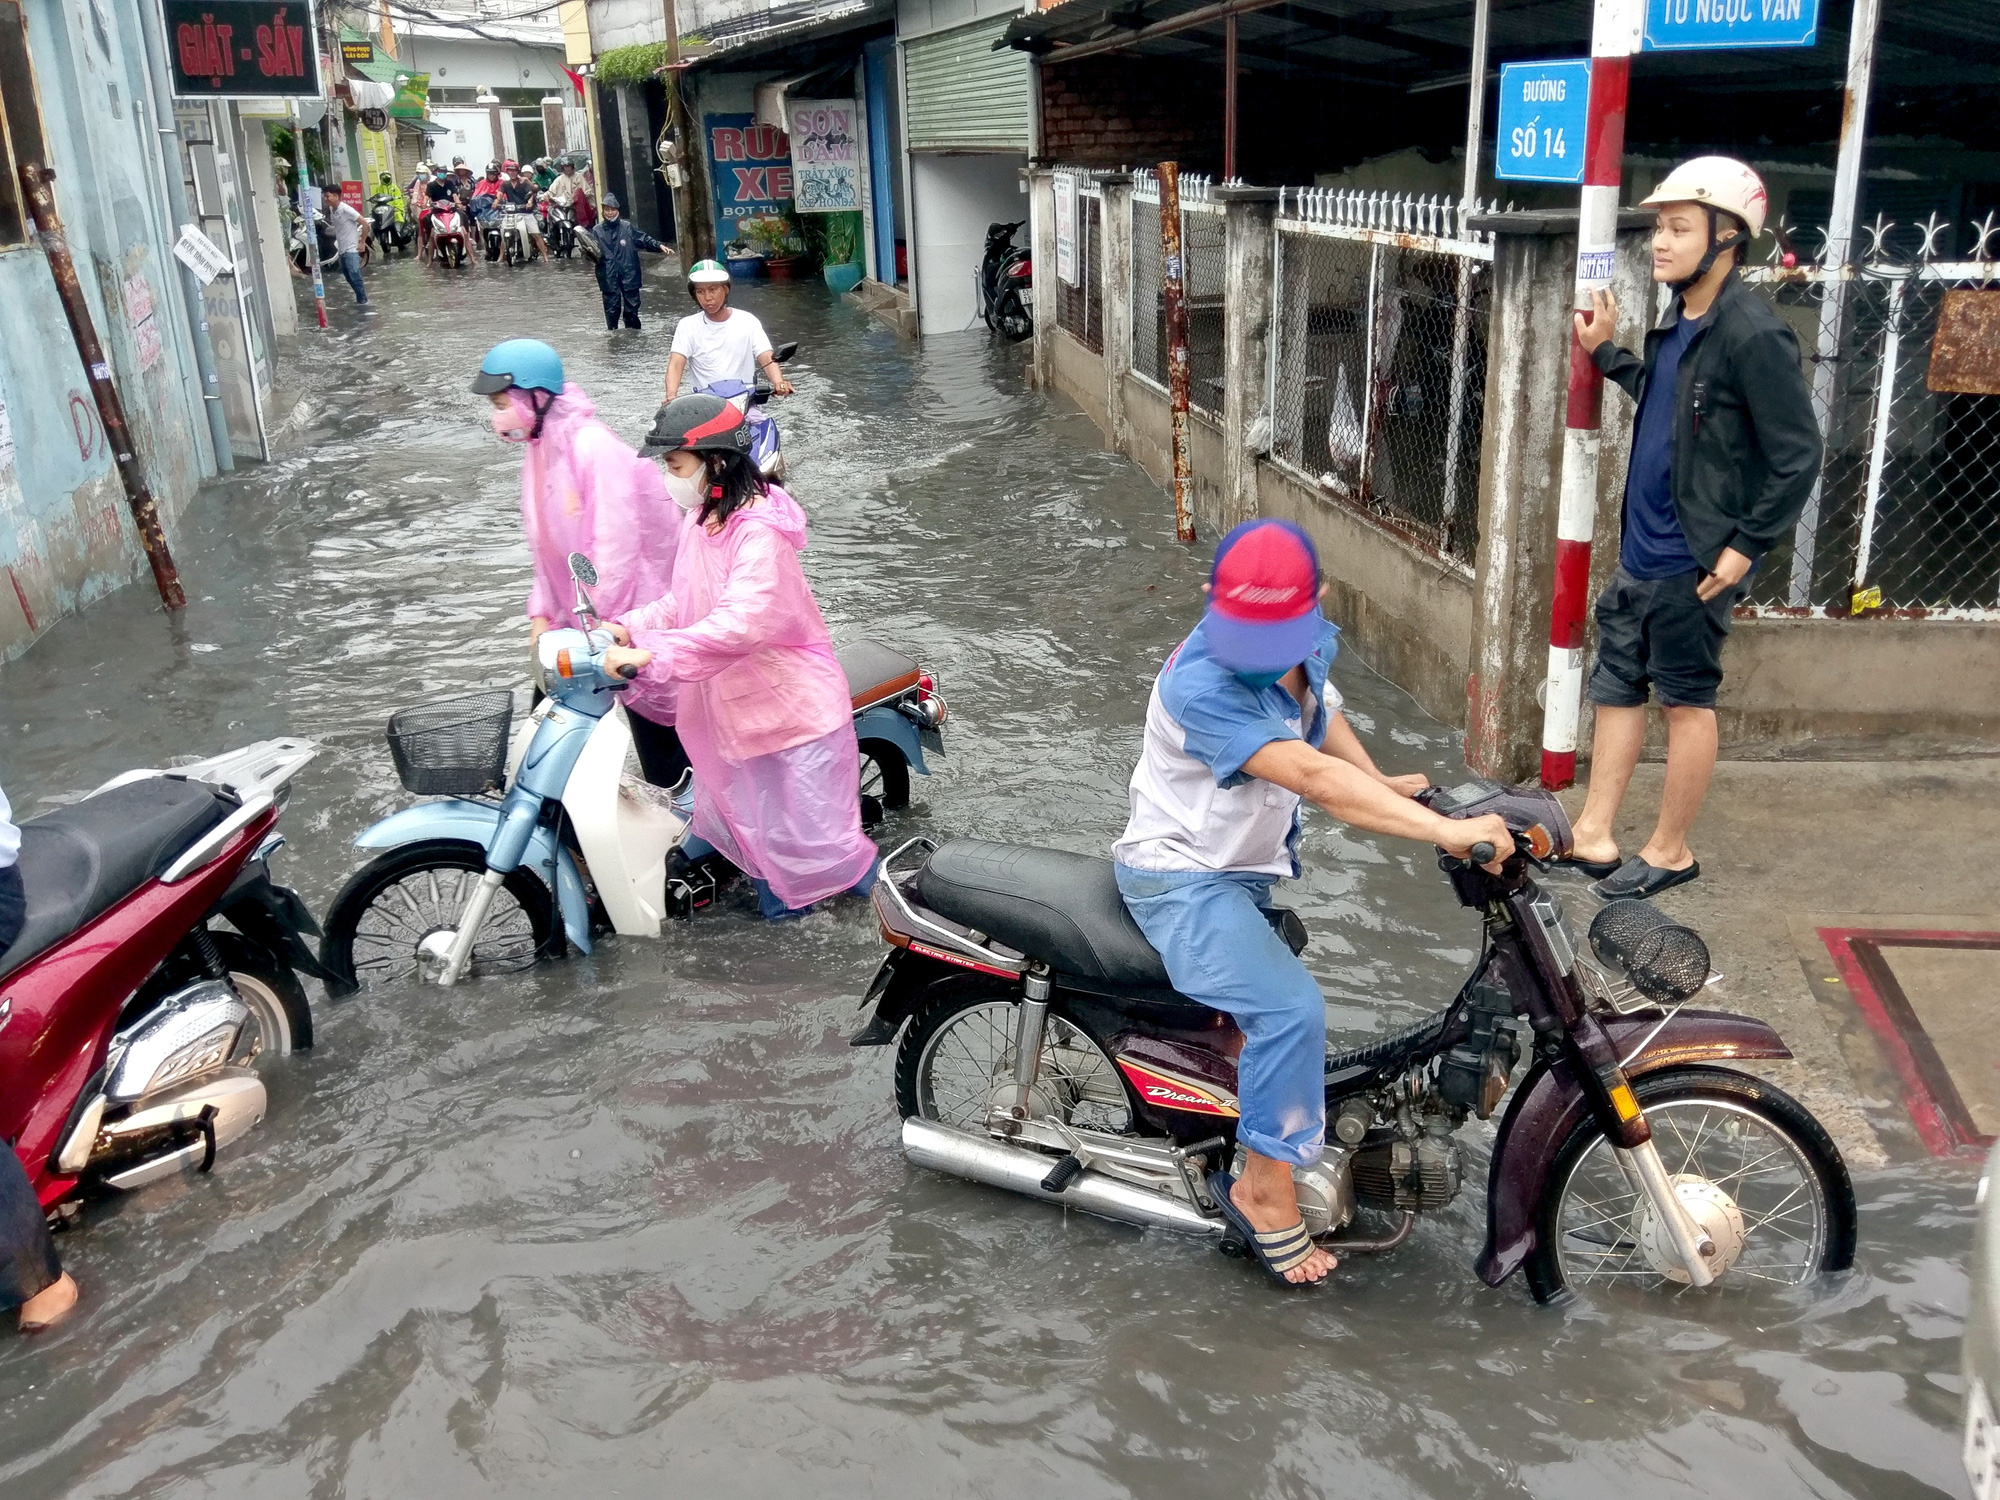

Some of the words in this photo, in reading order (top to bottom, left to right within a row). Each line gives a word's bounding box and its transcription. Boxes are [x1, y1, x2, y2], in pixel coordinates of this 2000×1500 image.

[177, 13, 235, 88] GIẶT
[256, 7, 304, 77] SẤY
[1522, 74, 1567, 102] ĐƯỜNG
[794, 105, 850, 136] SƠN
[1511, 115, 1541, 158] SỐ
[1543, 127, 1566, 158] 14
[731, 166, 794, 201] XE
[723, 206, 755, 217] BỌT
[819, 197, 856, 207] HONDA
[914, 945, 945, 959] ELECTRIC
[945, 955, 975, 967] STARTER
[1145, 1085, 1220, 1105] Dream
